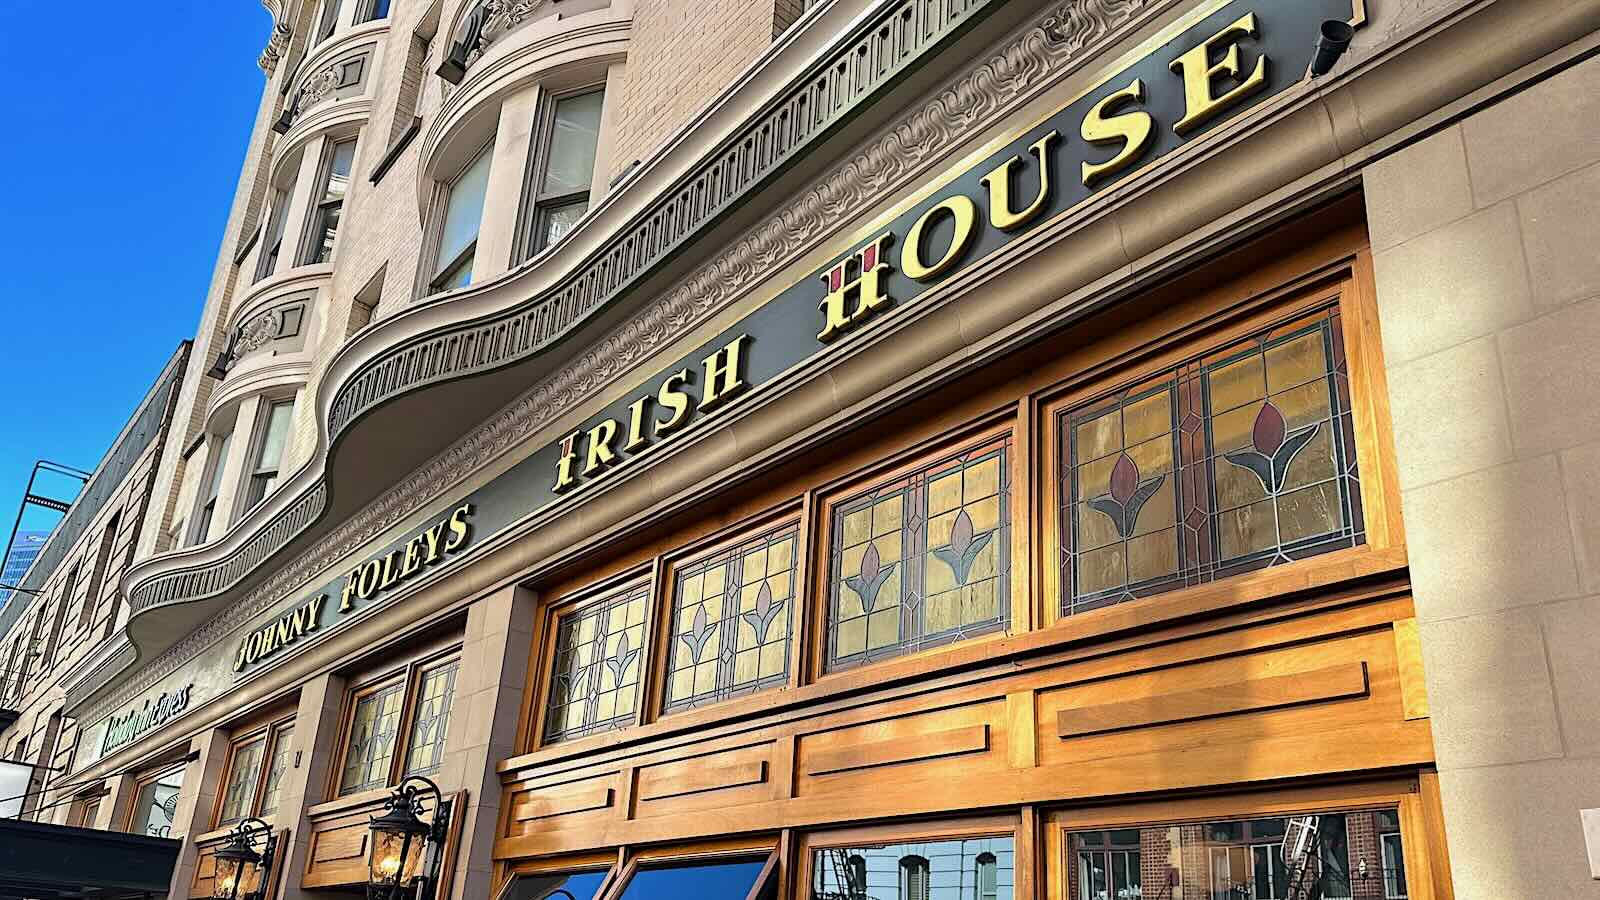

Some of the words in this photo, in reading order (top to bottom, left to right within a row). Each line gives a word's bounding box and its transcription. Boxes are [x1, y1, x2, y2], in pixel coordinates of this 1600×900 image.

[233, 593, 326, 672] JOHNNY
[337, 503, 472, 613] FOLEYS
[551, 333, 751, 494] IRISH
[816, 12, 1269, 342] HOUSE
